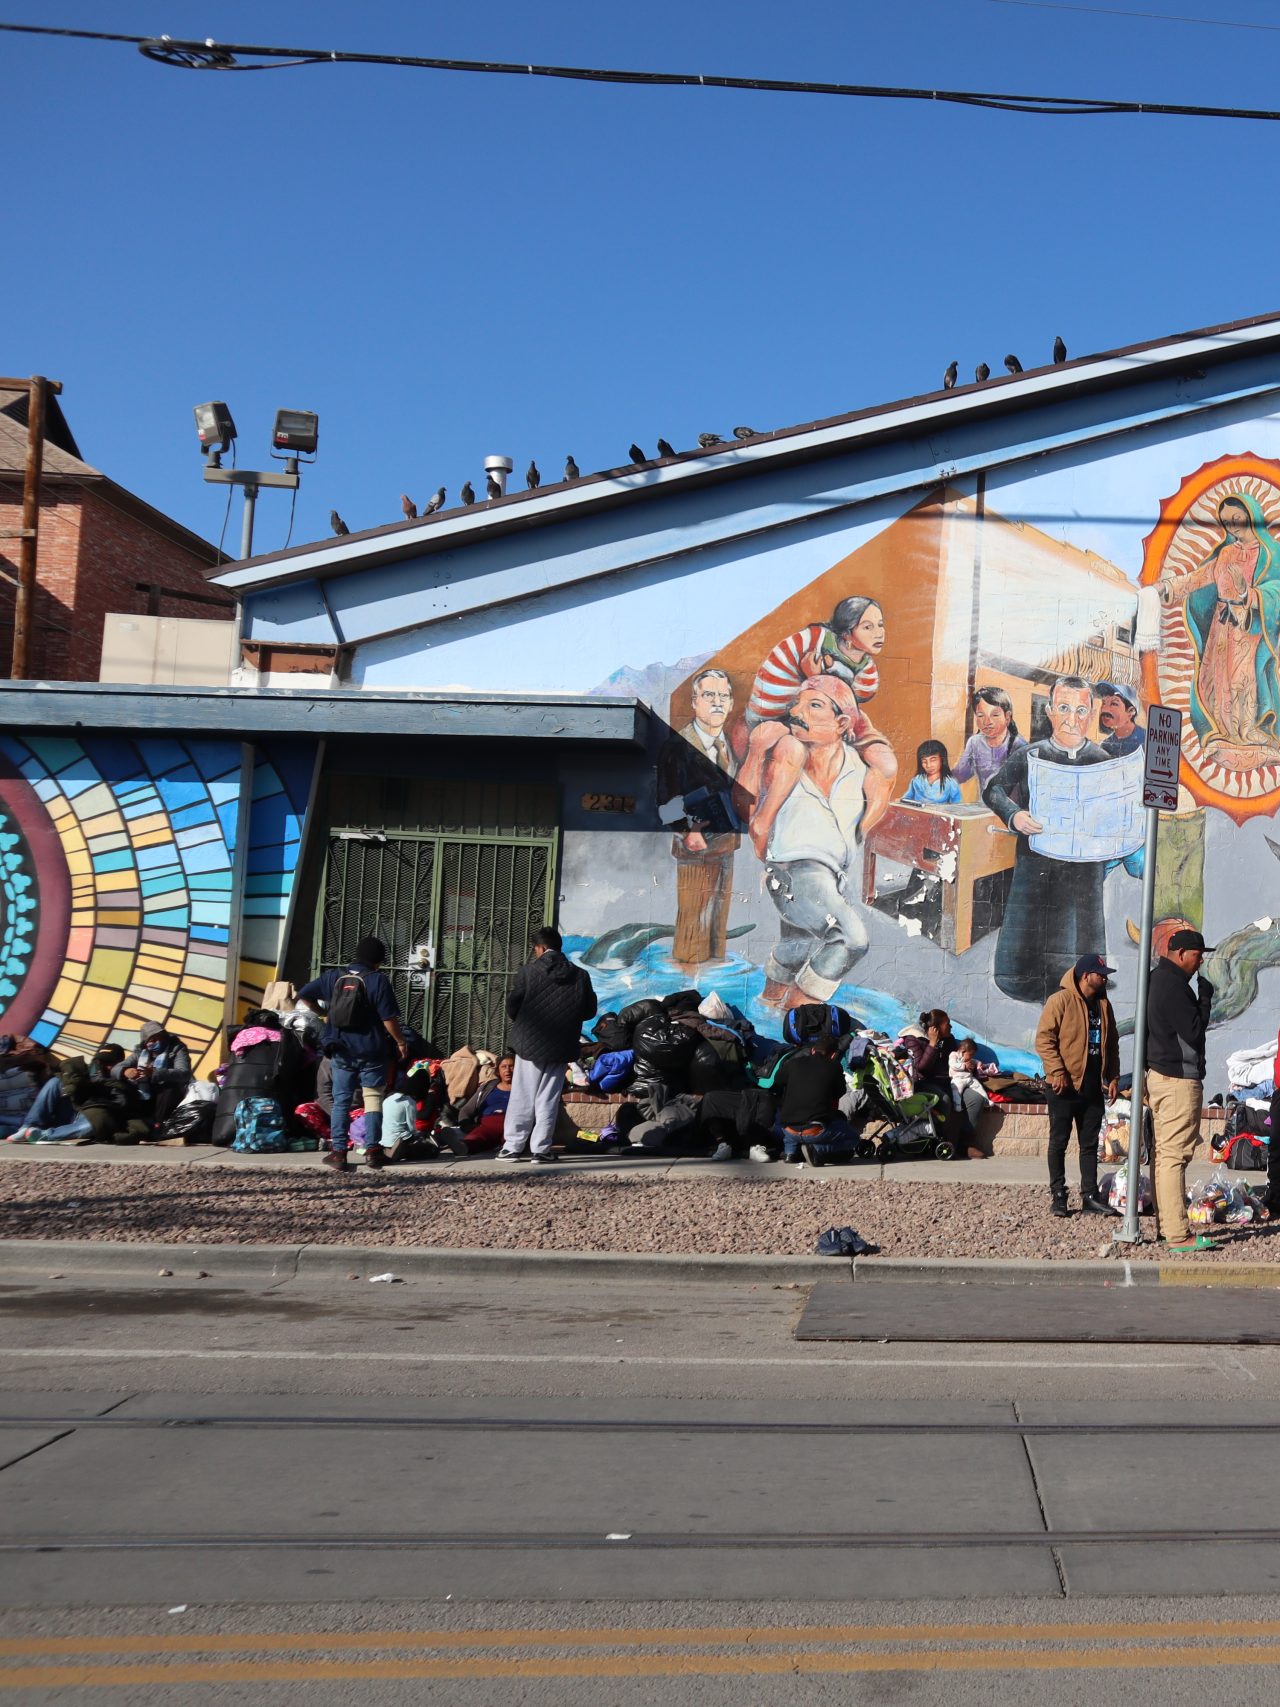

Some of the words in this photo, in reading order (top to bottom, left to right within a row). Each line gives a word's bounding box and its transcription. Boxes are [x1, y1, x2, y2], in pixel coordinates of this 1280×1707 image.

[1158, 713, 1172, 728] NO
[1149, 728, 1179, 746] PARKING
[1156, 746, 1171, 756] ANY
[1155, 756, 1171, 768] TIME
